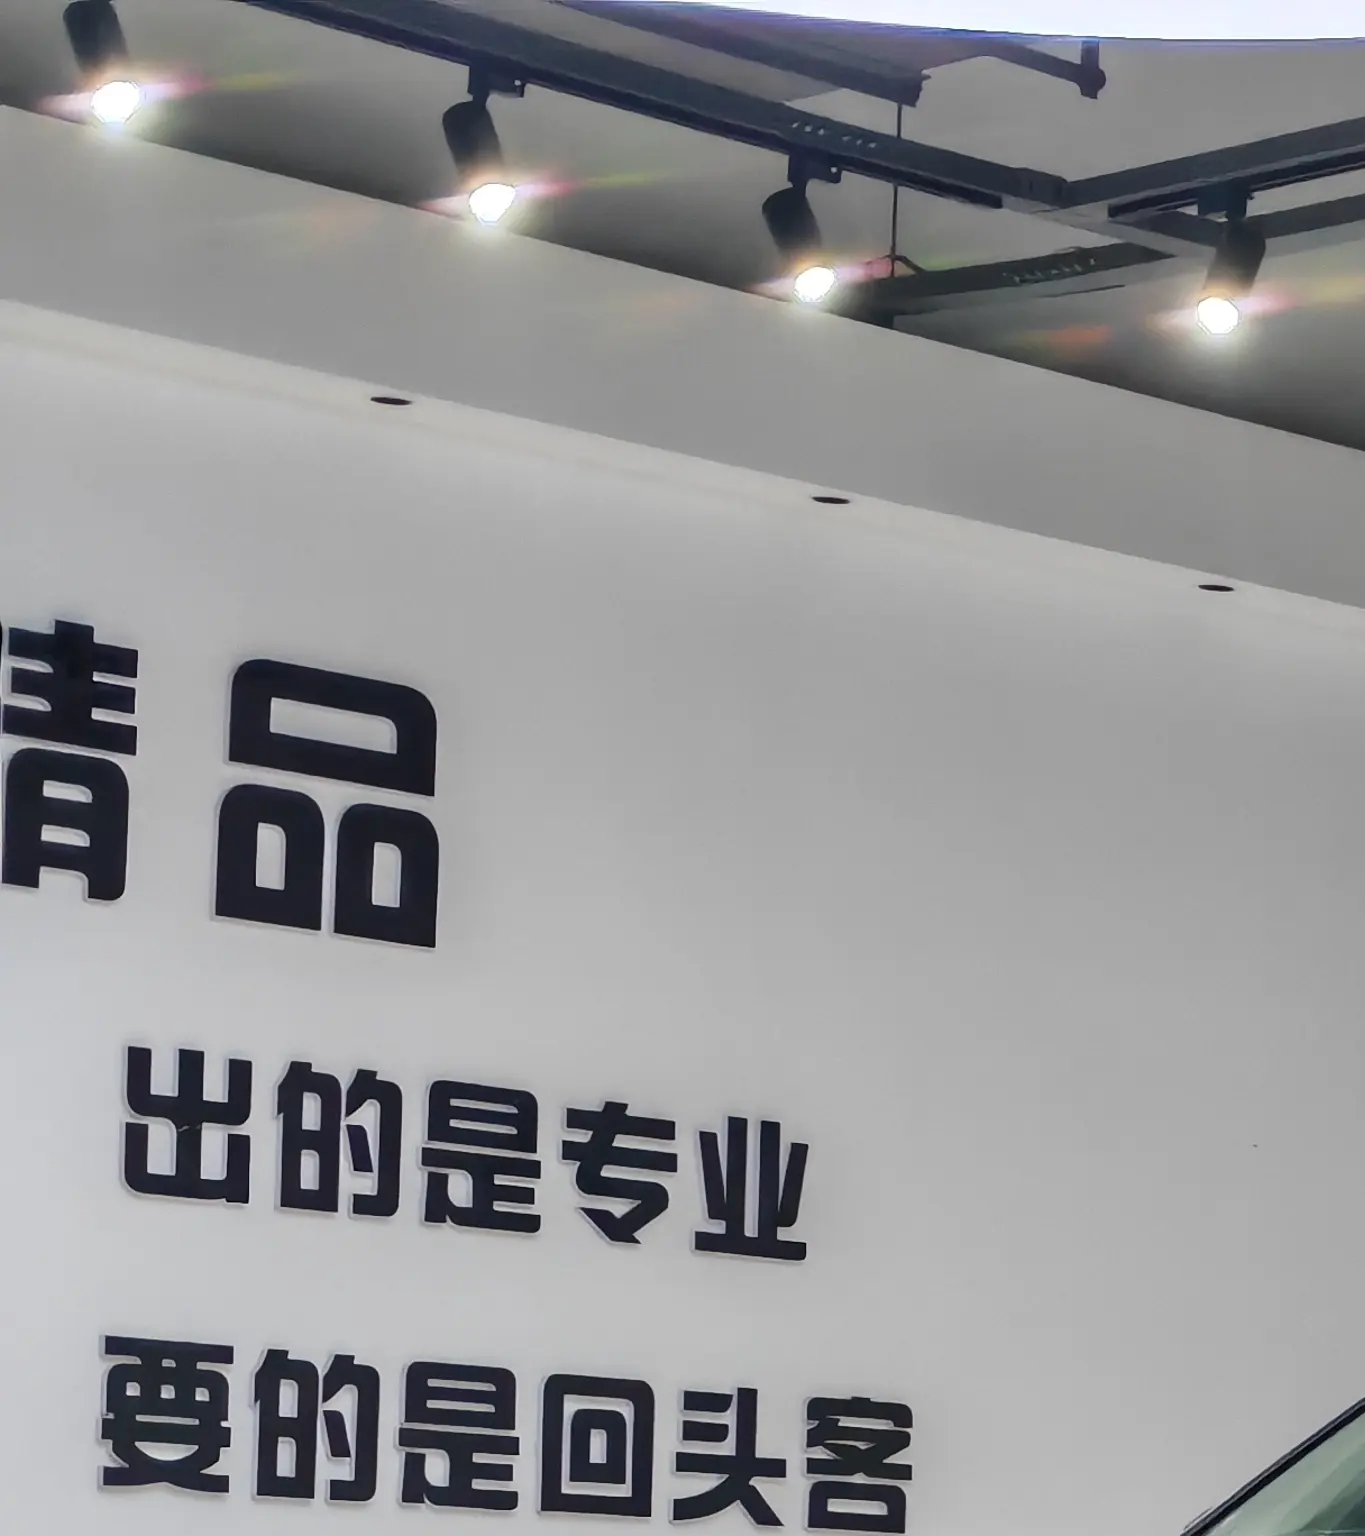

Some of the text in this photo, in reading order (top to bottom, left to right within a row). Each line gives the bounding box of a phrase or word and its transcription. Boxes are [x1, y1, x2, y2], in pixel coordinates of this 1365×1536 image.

[123, 1045, 809, 1262] 出的是专业
[99, 1335, 914, 1536] 要的是回头客
